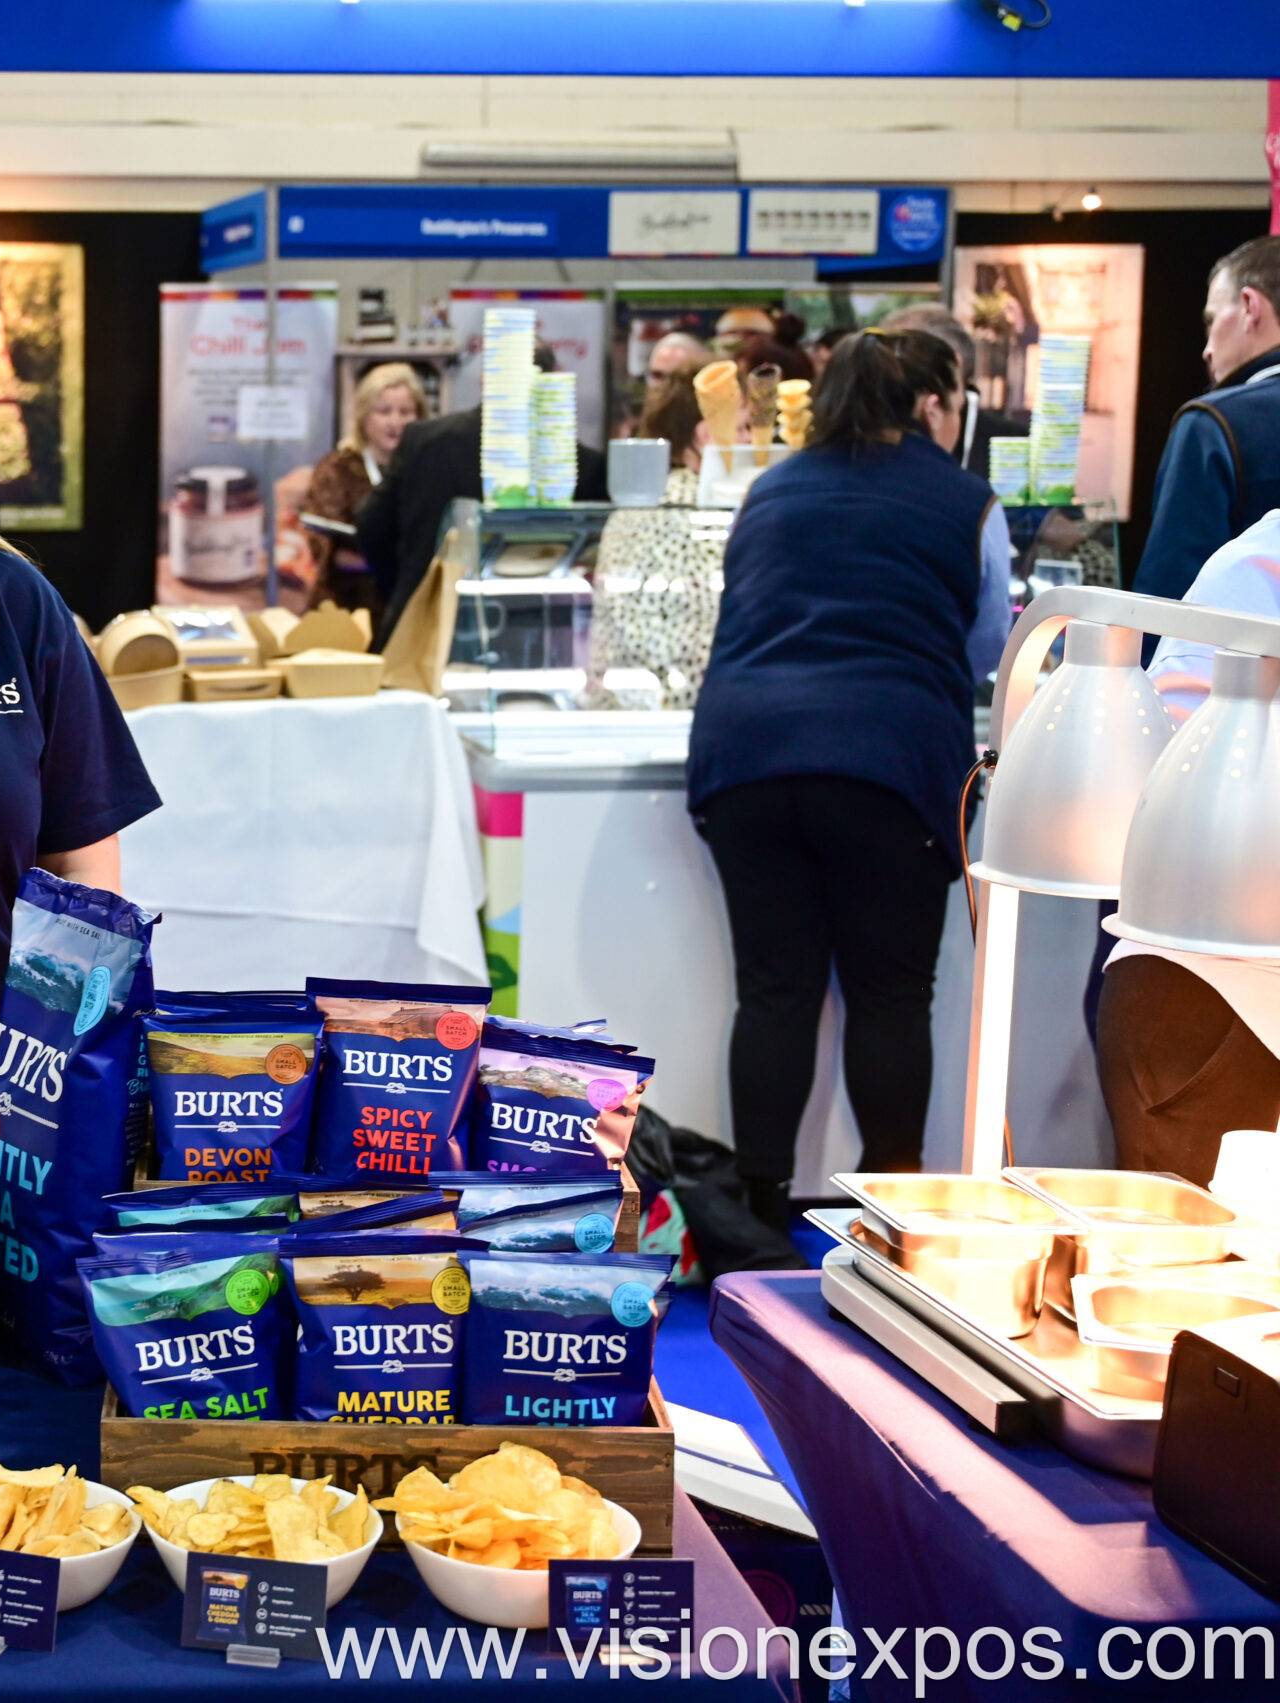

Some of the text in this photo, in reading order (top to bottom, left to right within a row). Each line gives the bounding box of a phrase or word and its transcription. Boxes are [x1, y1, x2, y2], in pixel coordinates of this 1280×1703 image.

[343, 1049, 453, 1082] BURTS
[174, 1091, 284, 1117] BURTS
[361, 1107, 433, 1129] SPICY
[491, 1102, 599, 1144] BURTS
[352, 1129, 437, 1153] SWEET
[185, 1148, 272, 1168] DEVON
[356, 1151, 432, 1175] CHILLI
[135, 1325, 256, 1371] BURTS
[333, 1324, 455, 1355] BURTS
[503, 1330, 628, 1364] BURTS
[143, 1387, 269, 1420] SEA SALT
[337, 1390, 451, 1412] MATURE
[505, 1395, 617, 1420] LIGHTLY
